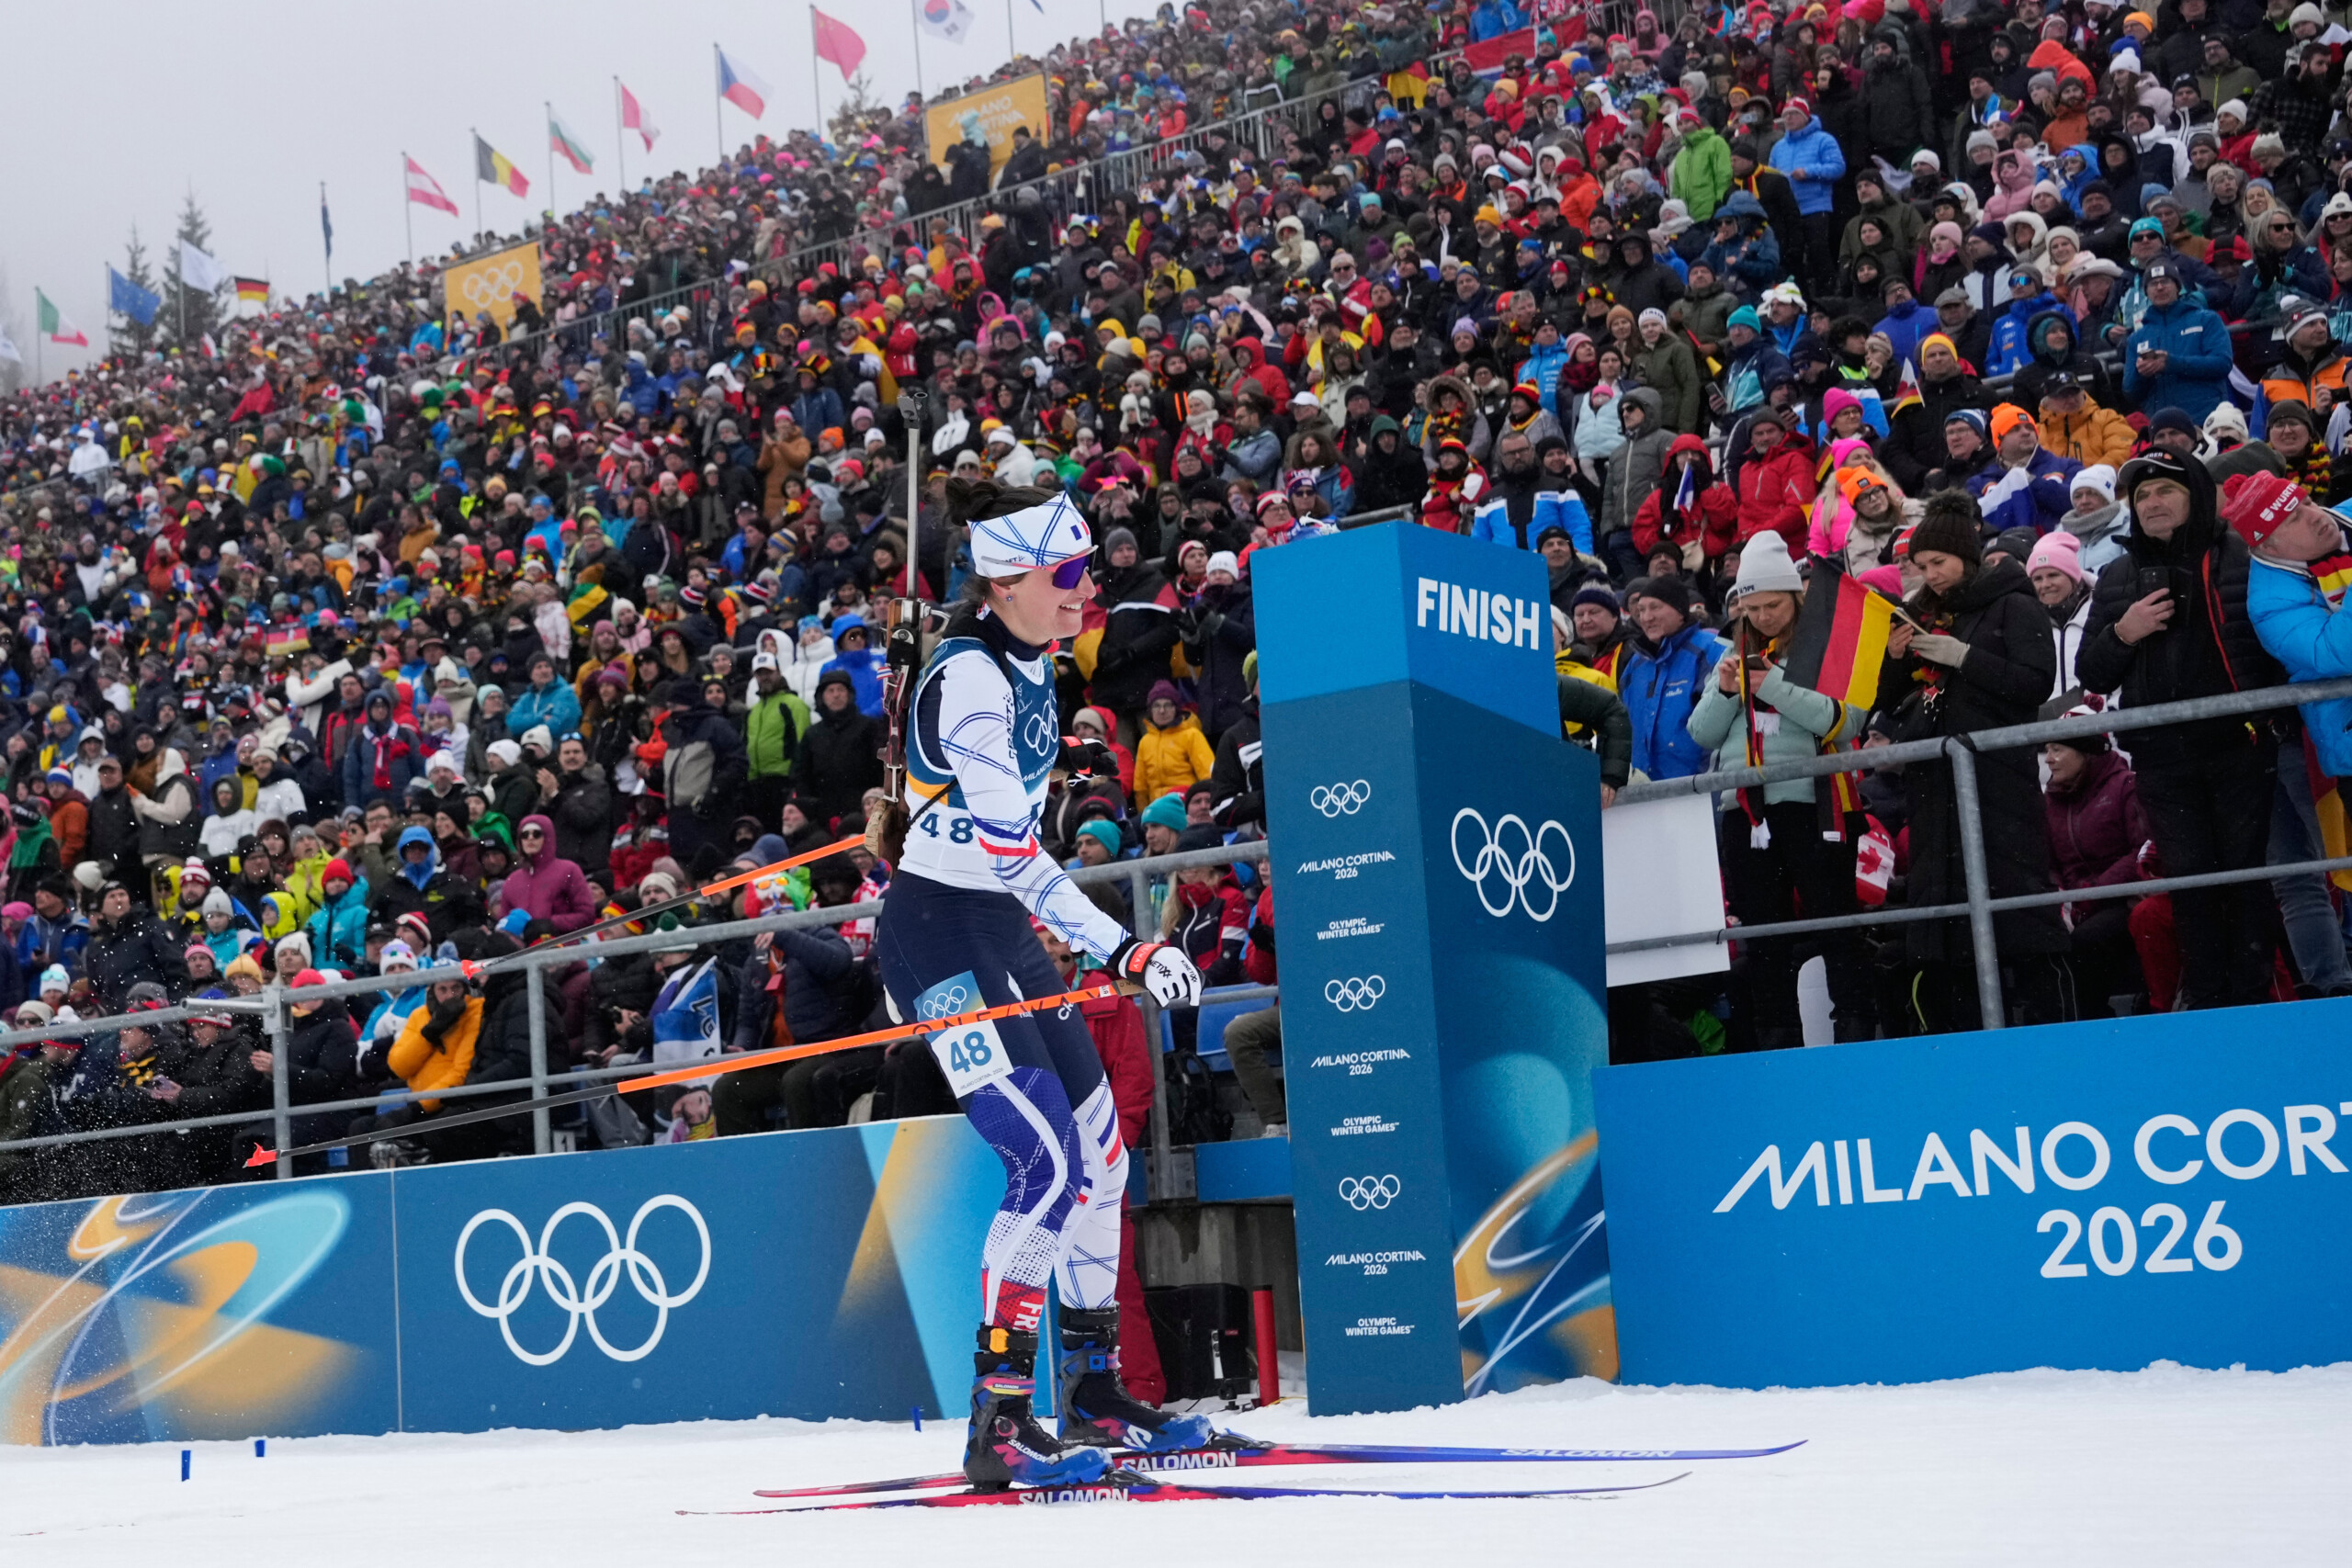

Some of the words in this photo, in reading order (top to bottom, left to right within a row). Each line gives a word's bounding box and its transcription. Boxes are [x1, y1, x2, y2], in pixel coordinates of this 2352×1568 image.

[1417, 577, 1540, 650] FINISH
[1022, 762, 1047, 783] MILANO
[920, 813, 975, 844] 48
[1296, 857, 1344, 874] MILANO
[1345, 851, 1396, 866] CORTINA
[1335, 867, 1358, 880] 2026
[1329, 917, 1367, 931] OLYMPIC
[1317, 928, 1349, 941] WINTER
[950, 1031, 992, 1073] 48
[1311, 1054, 1359, 1068] MILANO
[1360, 1048, 1411, 1063] CORTINA
[1349, 1064, 1373, 1076] 2026
[1342, 1115, 1382, 1127] OLYMPIC
[1330, 1126, 1363, 1136] WINTER
[1713, 1121, 2110, 1213] MILANO
[2133, 1100, 2352, 1185] COR
[2036, 1201, 2243, 1279] 2026
[1324, 1253, 1374, 1266] MILANO
[1374, 1250, 1427, 1263] CORTINA
[1363, 1264, 1388, 1276] 2026
[1357, 1317, 1396, 1327] OLYMPIC
[1345, 1326, 1378, 1337] WINTER
[1008, 1438, 1046, 1463] SALOMON
[1500, 1449, 1676, 1458] SALOMON
[1122, 1451, 1237, 1472] SALOMON
[1019, 1488, 1128, 1505] SALOMON
